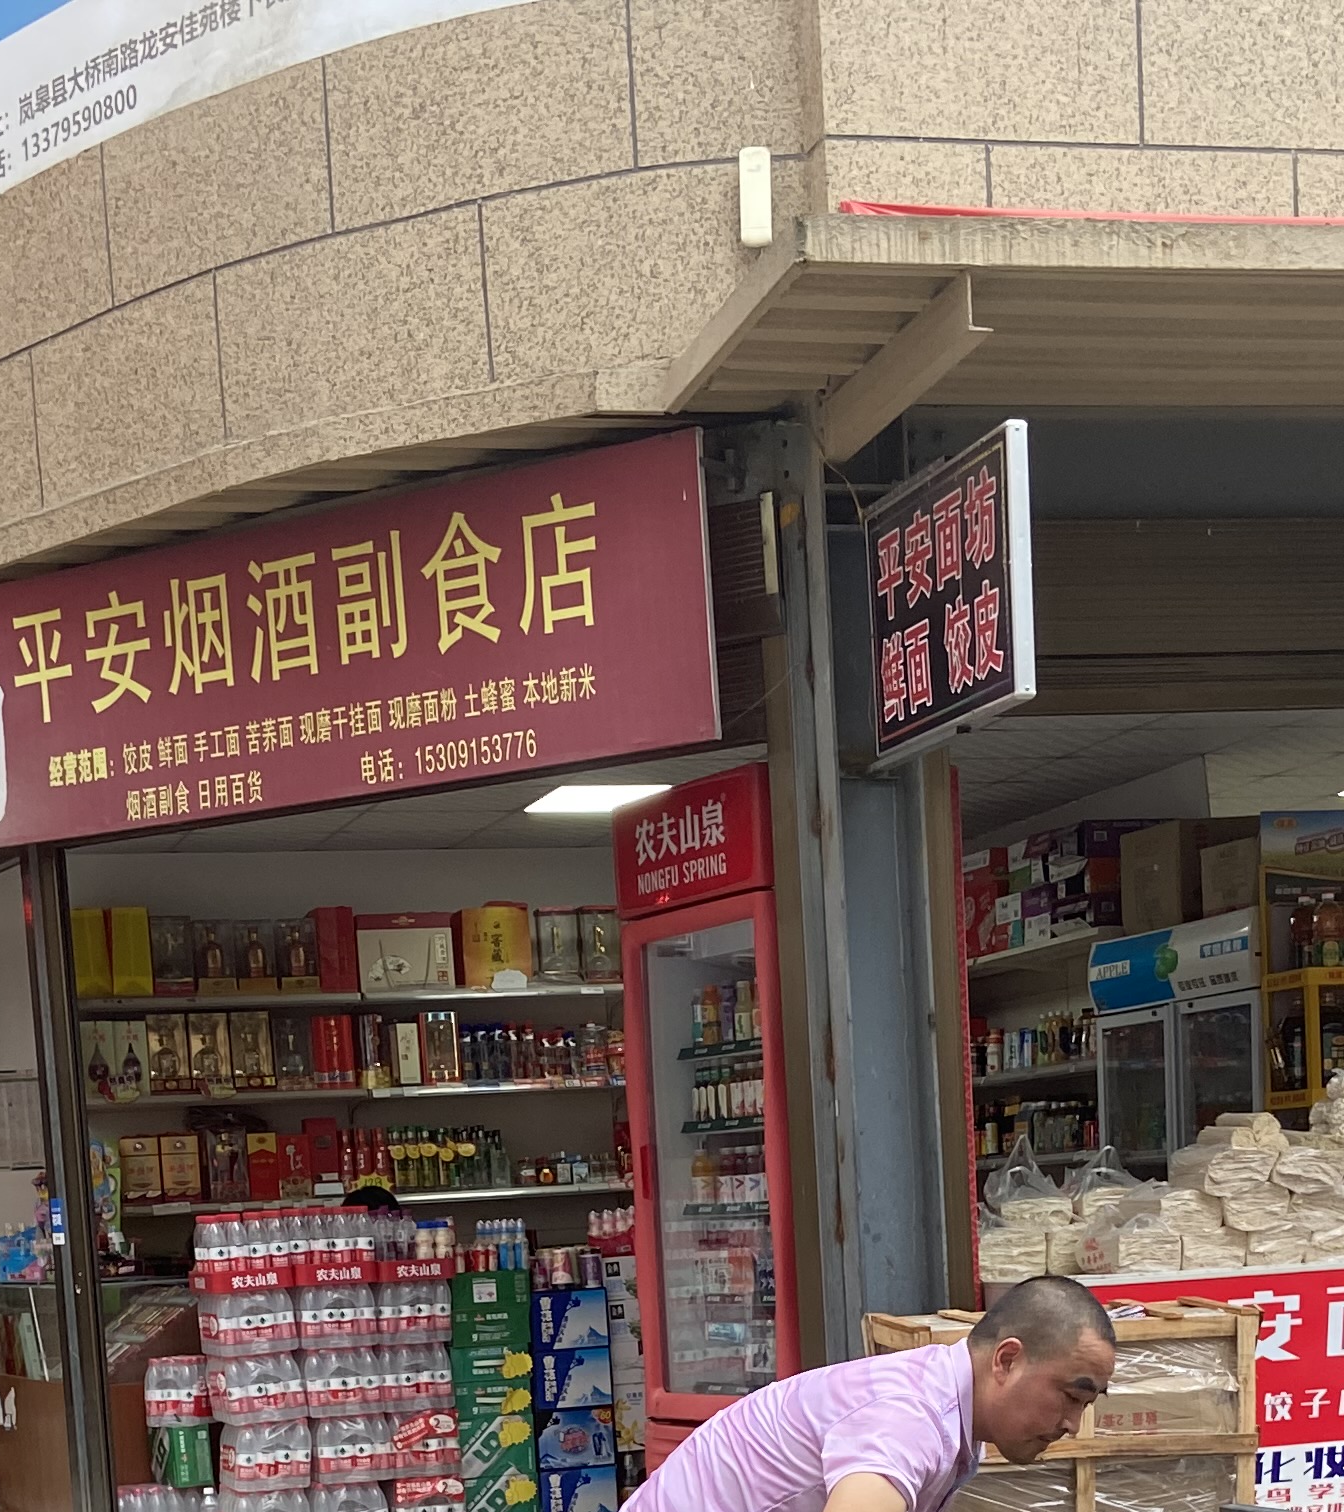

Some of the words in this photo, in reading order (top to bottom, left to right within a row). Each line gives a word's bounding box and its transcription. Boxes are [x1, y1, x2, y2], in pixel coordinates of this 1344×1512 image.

[877, 465, 997, 621] 平安面坊
[13, 492, 597, 724] 平安烟酒副食店
[880, 618, 933, 723] 鲜面
[944, 580, 1004, 693] 饺皮
[122, 738, 154, 777] 饺皮
[157, 733, 189, 770] 鲜面
[193, 725, 241, 763] 手工面
[245, 716, 295, 756] 苦荞面
[299, 700, 384, 749] 现磨干挂面
[388, 687, 459, 732] 现磨面粉
[463, 678, 517, 720] 土蜂蜜
[522, 662, 597, 711] 本地新米
[125, 779, 191, 822] 烟酒副食
[197, 770, 263, 809] 日用百货
[635, 799, 726, 867] 农夫山泉
[637, 864, 680, 896] NONGFU
[682, 853, 727, 884] SPRING
[1096, 961, 1129, 980] APPLE
[231, 1270, 278, 1289] 农夫山泉
[316, 1265, 363, 1281] 农夫山泉
[396, 1263, 442, 1278] 农夫山泉
[1255, 1486, 1291, 1506] 鸟
